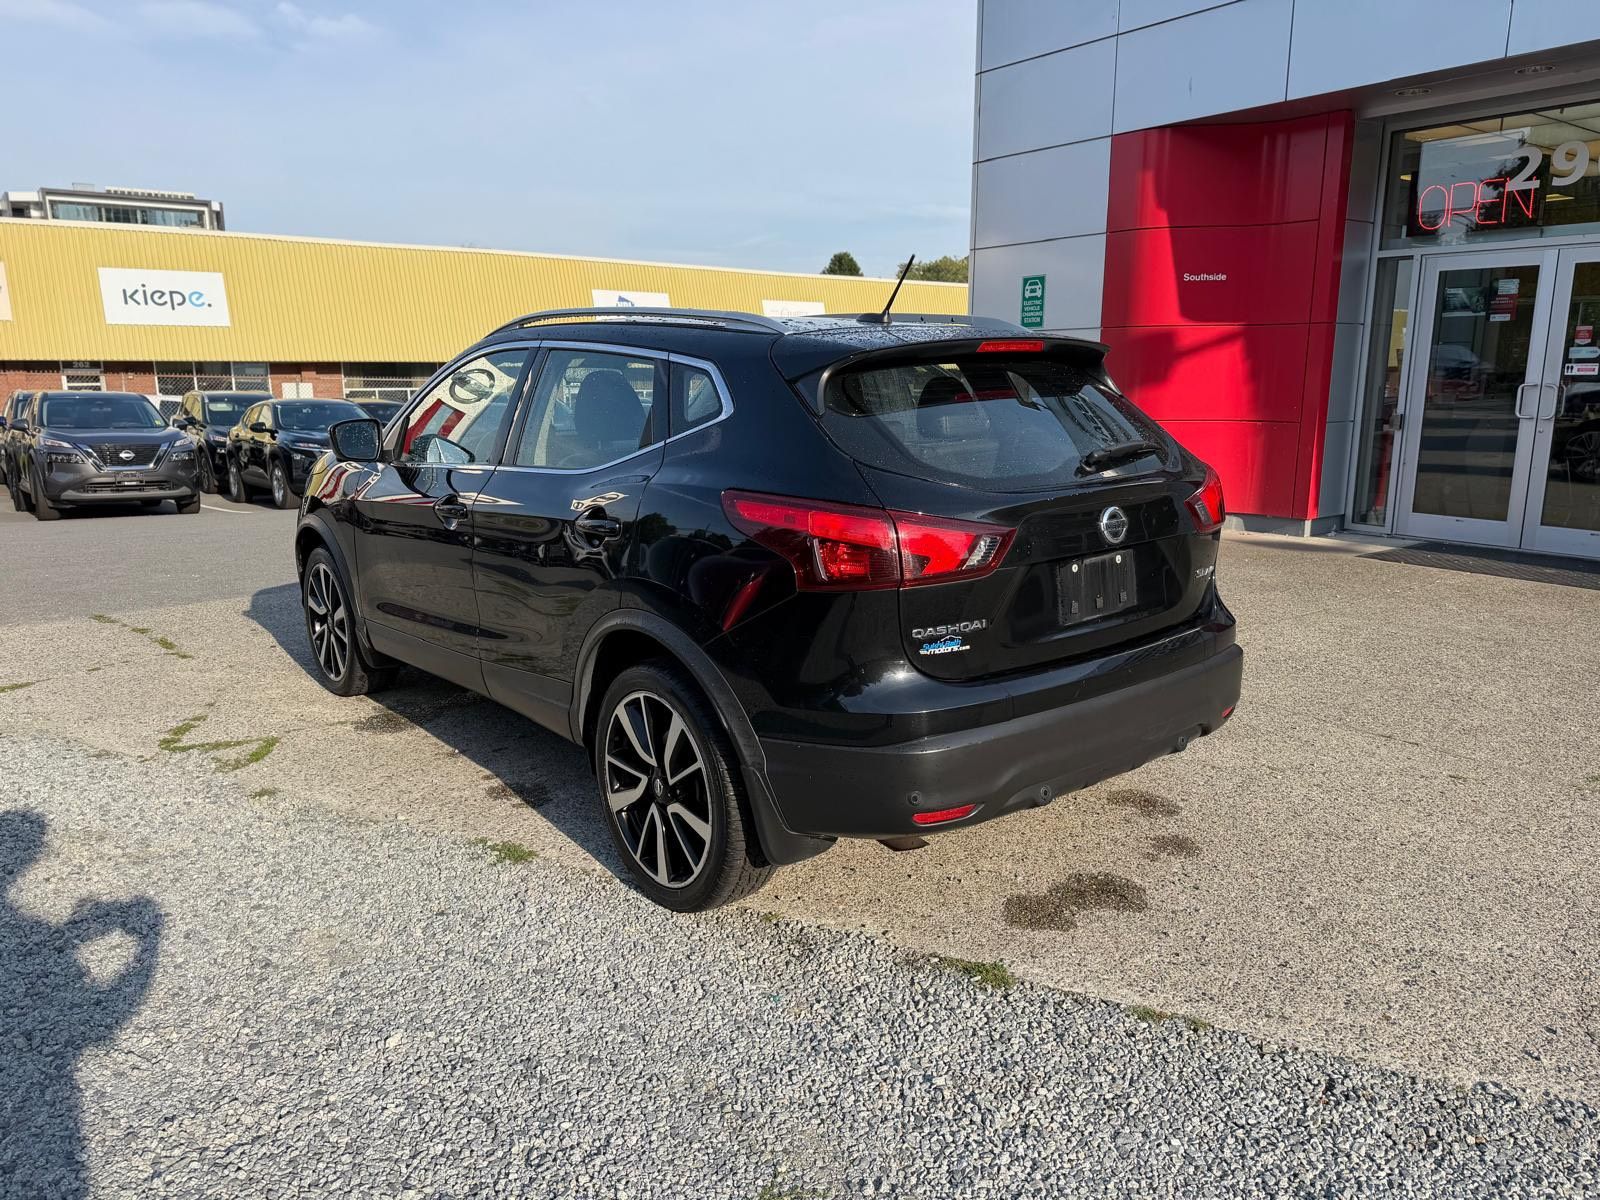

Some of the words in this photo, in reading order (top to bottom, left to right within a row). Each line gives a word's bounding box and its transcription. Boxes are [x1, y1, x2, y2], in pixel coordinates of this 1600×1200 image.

[1508, 140, 1600, 192] 29
[1418, 176, 1537, 230] OPEN
[1183, 272, 1227, 281] Southside
[911, 619, 986, 640] QASHQAI
